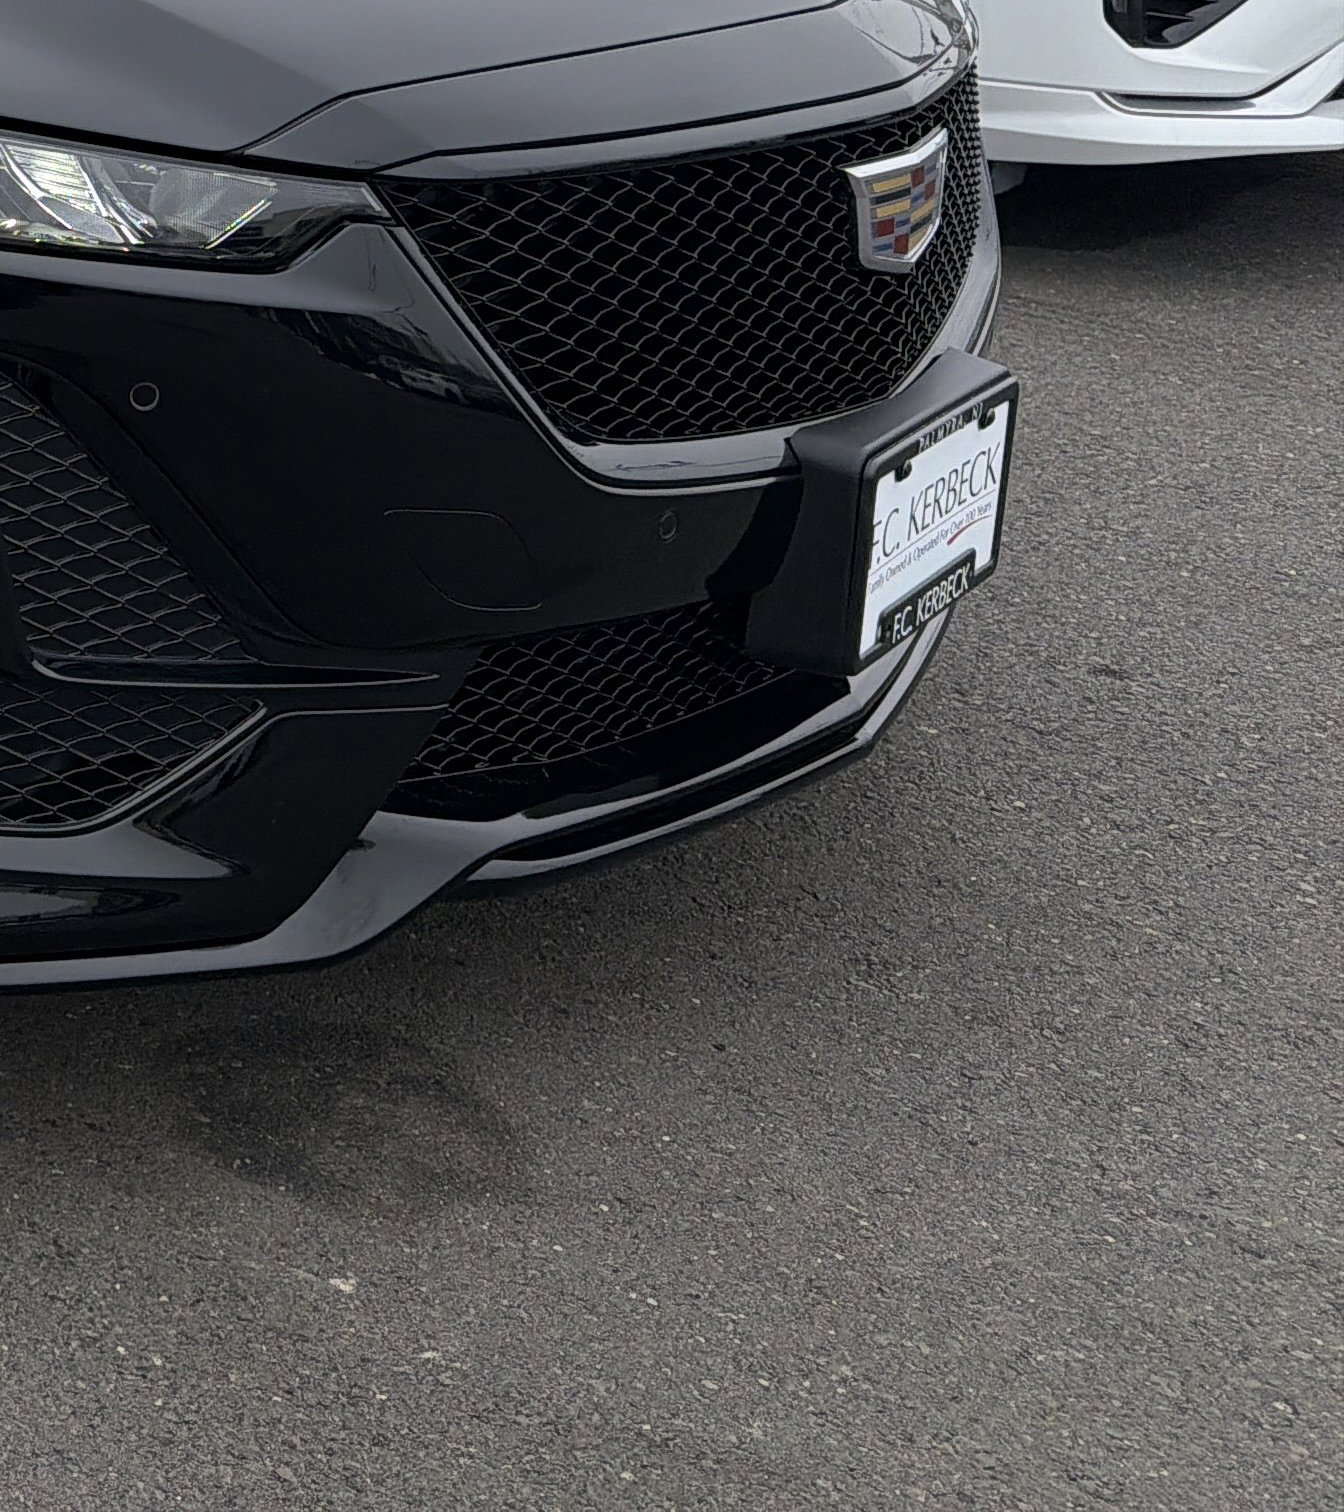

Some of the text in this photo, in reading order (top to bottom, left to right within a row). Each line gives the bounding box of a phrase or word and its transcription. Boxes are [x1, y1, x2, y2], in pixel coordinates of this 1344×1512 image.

[918, 413, 965, 454] PALMYRA,
[907, 441, 1001, 542] KERBECK
[885, 559, 908, 582] Owned
[949, 517, 965, 537] Over
[976, 500, 994, 521] Years
[892, 563, 971, 644] F.C. KERBECK
